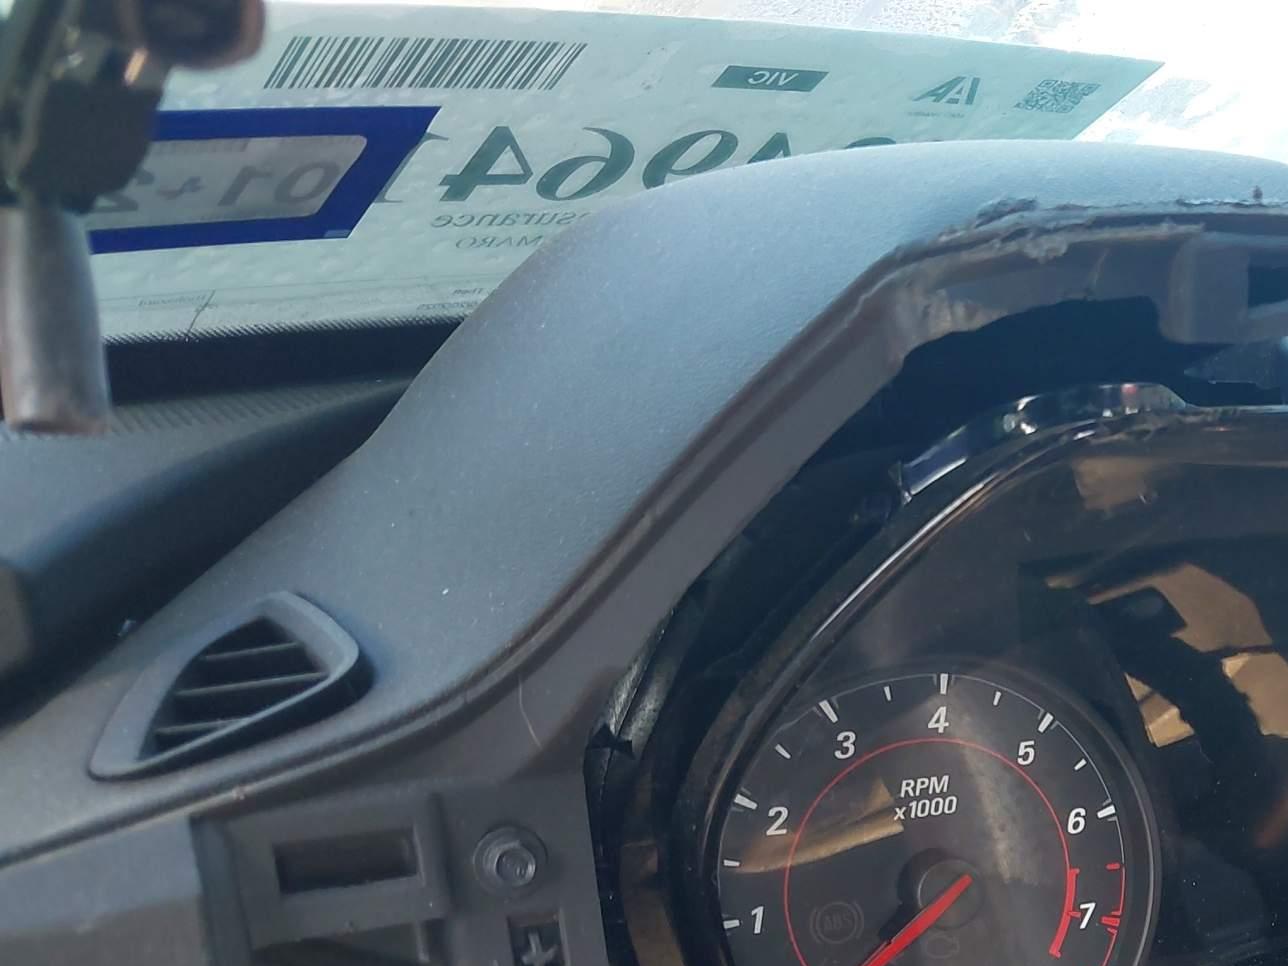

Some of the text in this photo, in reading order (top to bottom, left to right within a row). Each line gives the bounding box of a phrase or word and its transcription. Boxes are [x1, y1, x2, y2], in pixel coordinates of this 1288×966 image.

[927, 705, 950, 734] 4
[834, 731, 856, 759] 3
[1017, 740, 1035, 765] 5
[900, 775, 950, 798] RPM
[766, 806, 789, 836] 2
[893, 795, 958, 821] x1000
[1067, 807, 1087, 835] 6
[750, 905, 765, 935] 1
[1079, 902, 1096, 930] 7
